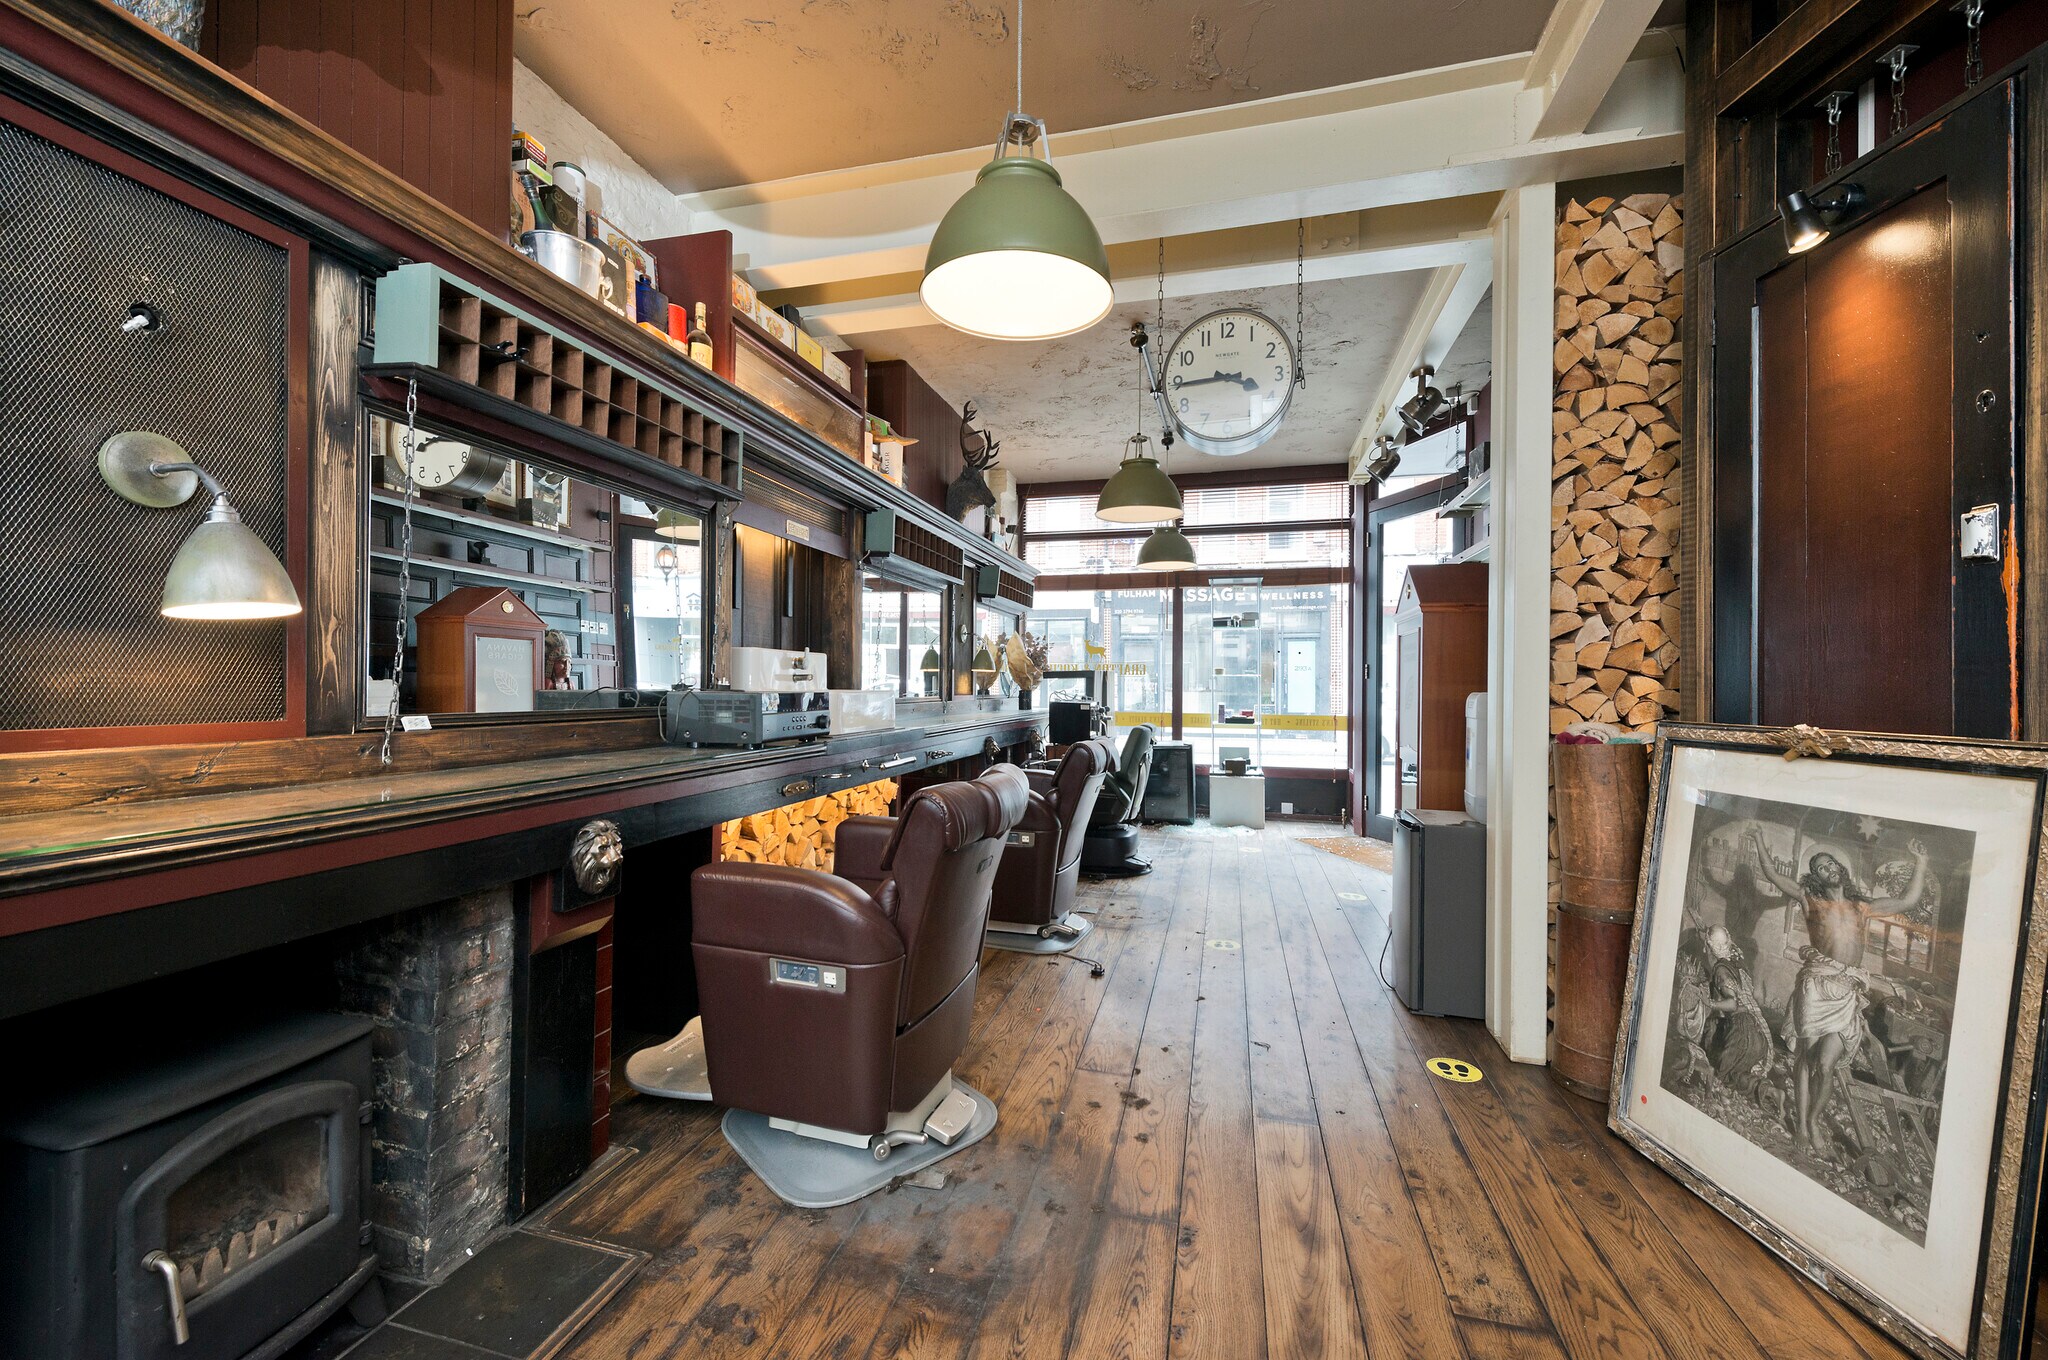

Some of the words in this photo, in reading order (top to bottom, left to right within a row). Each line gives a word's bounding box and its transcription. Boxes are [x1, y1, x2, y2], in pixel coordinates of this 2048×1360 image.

[1201, 330, 1211, 347] 11
[1220, 321, 1235, 339] 12
[1250, 325, 1254, 342] 1
[1180, 350, 1194, 367] 10
[1265, 342, 1276, 359] 2
[1274, 365, 1284, 382] 3
[1172, 375, 1183, 391] 9
[1179, 397, 1189, 413] 8
[1200, 413, 1210, 428] 7
[1222, 419, 1232, 434] 6
[1117, 589, 1156, 599] FULHAM
[1160, 587, 1245, 603] MSSAGE
[1260, 591, 1324, 601] WELLNESS
